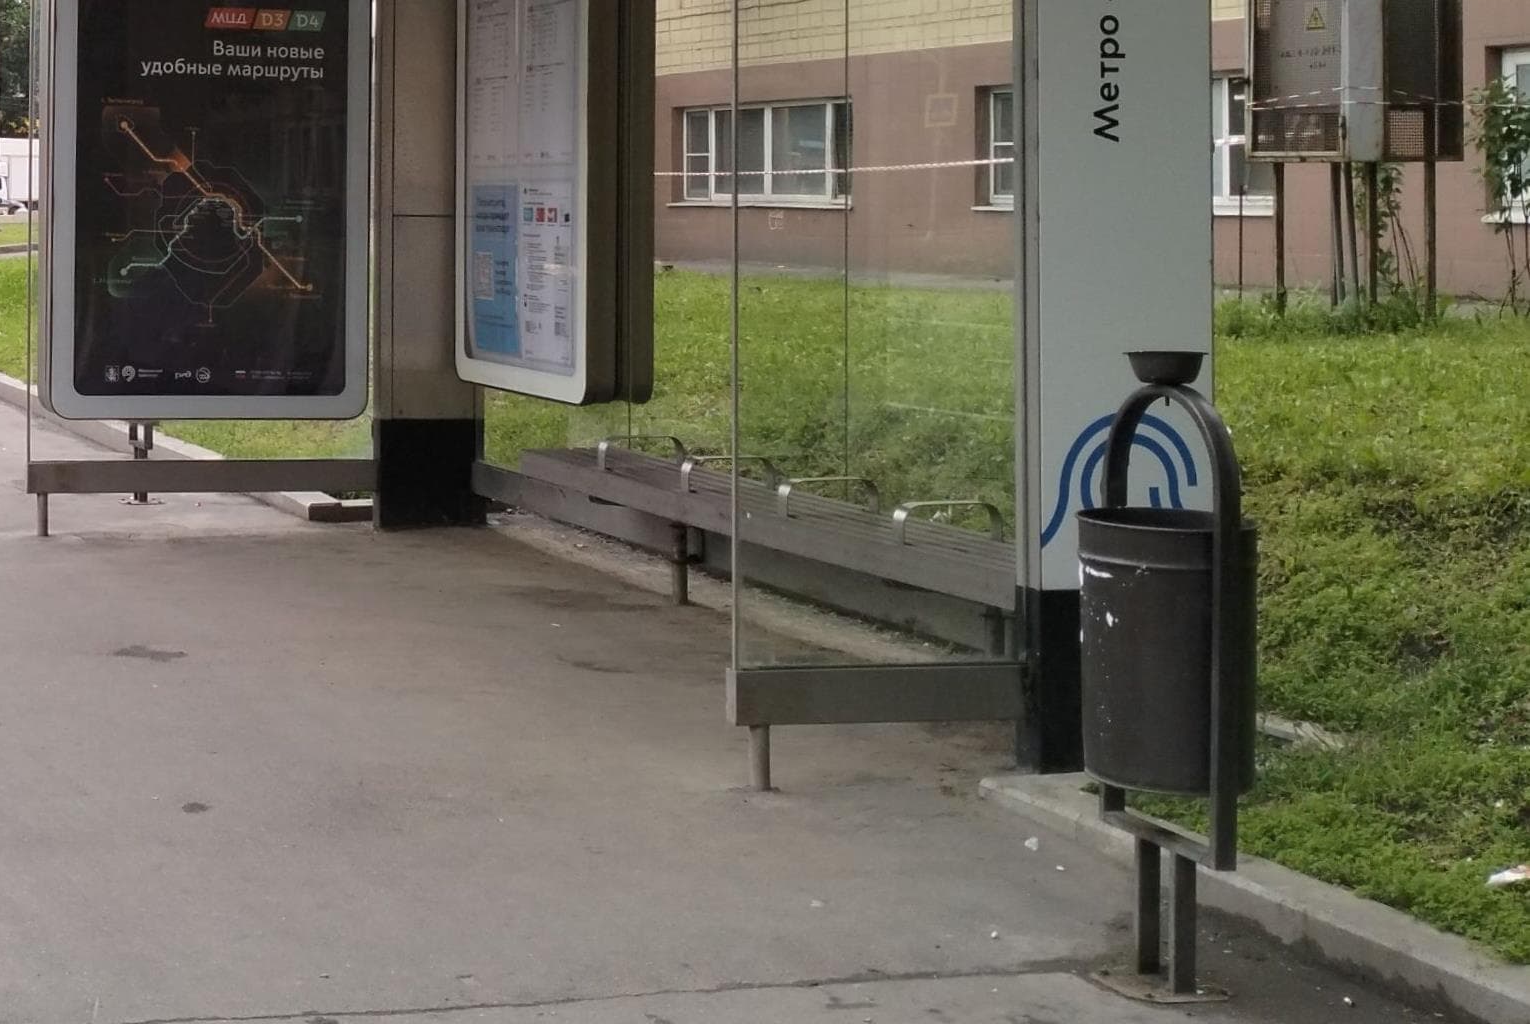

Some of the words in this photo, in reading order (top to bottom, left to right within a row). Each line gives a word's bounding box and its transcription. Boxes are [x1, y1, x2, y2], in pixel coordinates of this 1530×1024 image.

[210, 12, 247, 25] МЦД
[261, 13, 285, 27] D3
[296, 14, 320, 28] D4
[213, 40, 262, 57] Ваши
[267, 45, 325, 60] новые
[140, 57, 223, 77] удобные
[227, 63, 324, 82] маршруты
[1093, 13, 1126, 143] Метро
